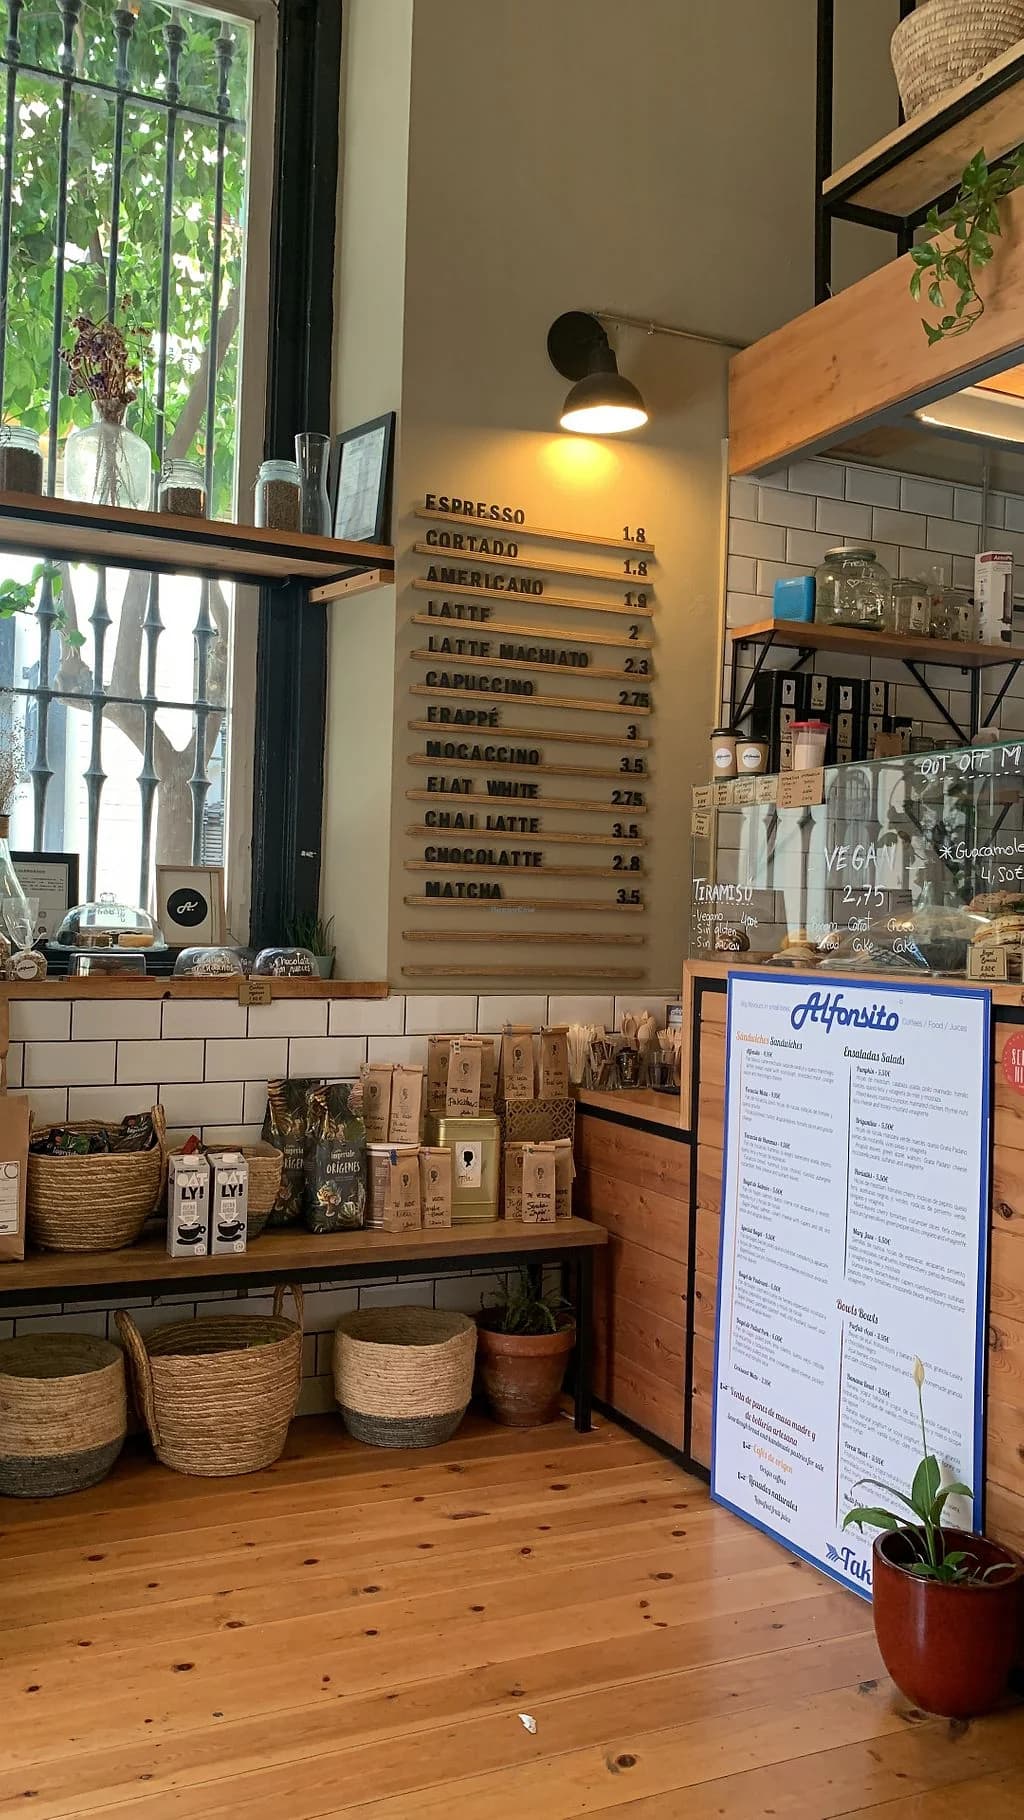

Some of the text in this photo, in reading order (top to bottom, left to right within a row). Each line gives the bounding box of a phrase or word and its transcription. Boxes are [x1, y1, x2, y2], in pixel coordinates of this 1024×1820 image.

[425, 493, 646, 543] ESPRESSO 1.8
[425, 529, 648, 577] CORTADO 1.8
[427, 565, 544, 596] AMERICANO
[427, 600, 639, 640] LATTE 2
[427, 636, 649, 675] LATTE MACHIATO 2.3
[425, 671, 534, 697] CAPUCCINO
[427, 706, 638, 740] FRAPPÉ 3
[426, 740, 644, 773] MOCACCINO 3.5
[921, 755, 951, 775] OUT
[959, 750, 990, 773] OFF
[486, 780, 539, 800] WHITE
[425, 810, 639, 839] CHAI LATTE 3.5
[424, 846, 641, 871] CHOCOLATTE 2.8
[824, 842, 897, 873] VEGAN
[425, 881, 641, 905] MATCHA 3.5
[842, 885, 885, 907] 2,75
[791, 991, 899, 1034] Alfonsito
[843, 1045, 905, 1066] Ensaladas Salads
[326, 1160, 361, 1175] ORÍGENES
[181, 1186, 205, 1200] LY!
[221, 1183, 244, 1198] LY!
[835, 1298, 879, 1325] Bowls Bowls
